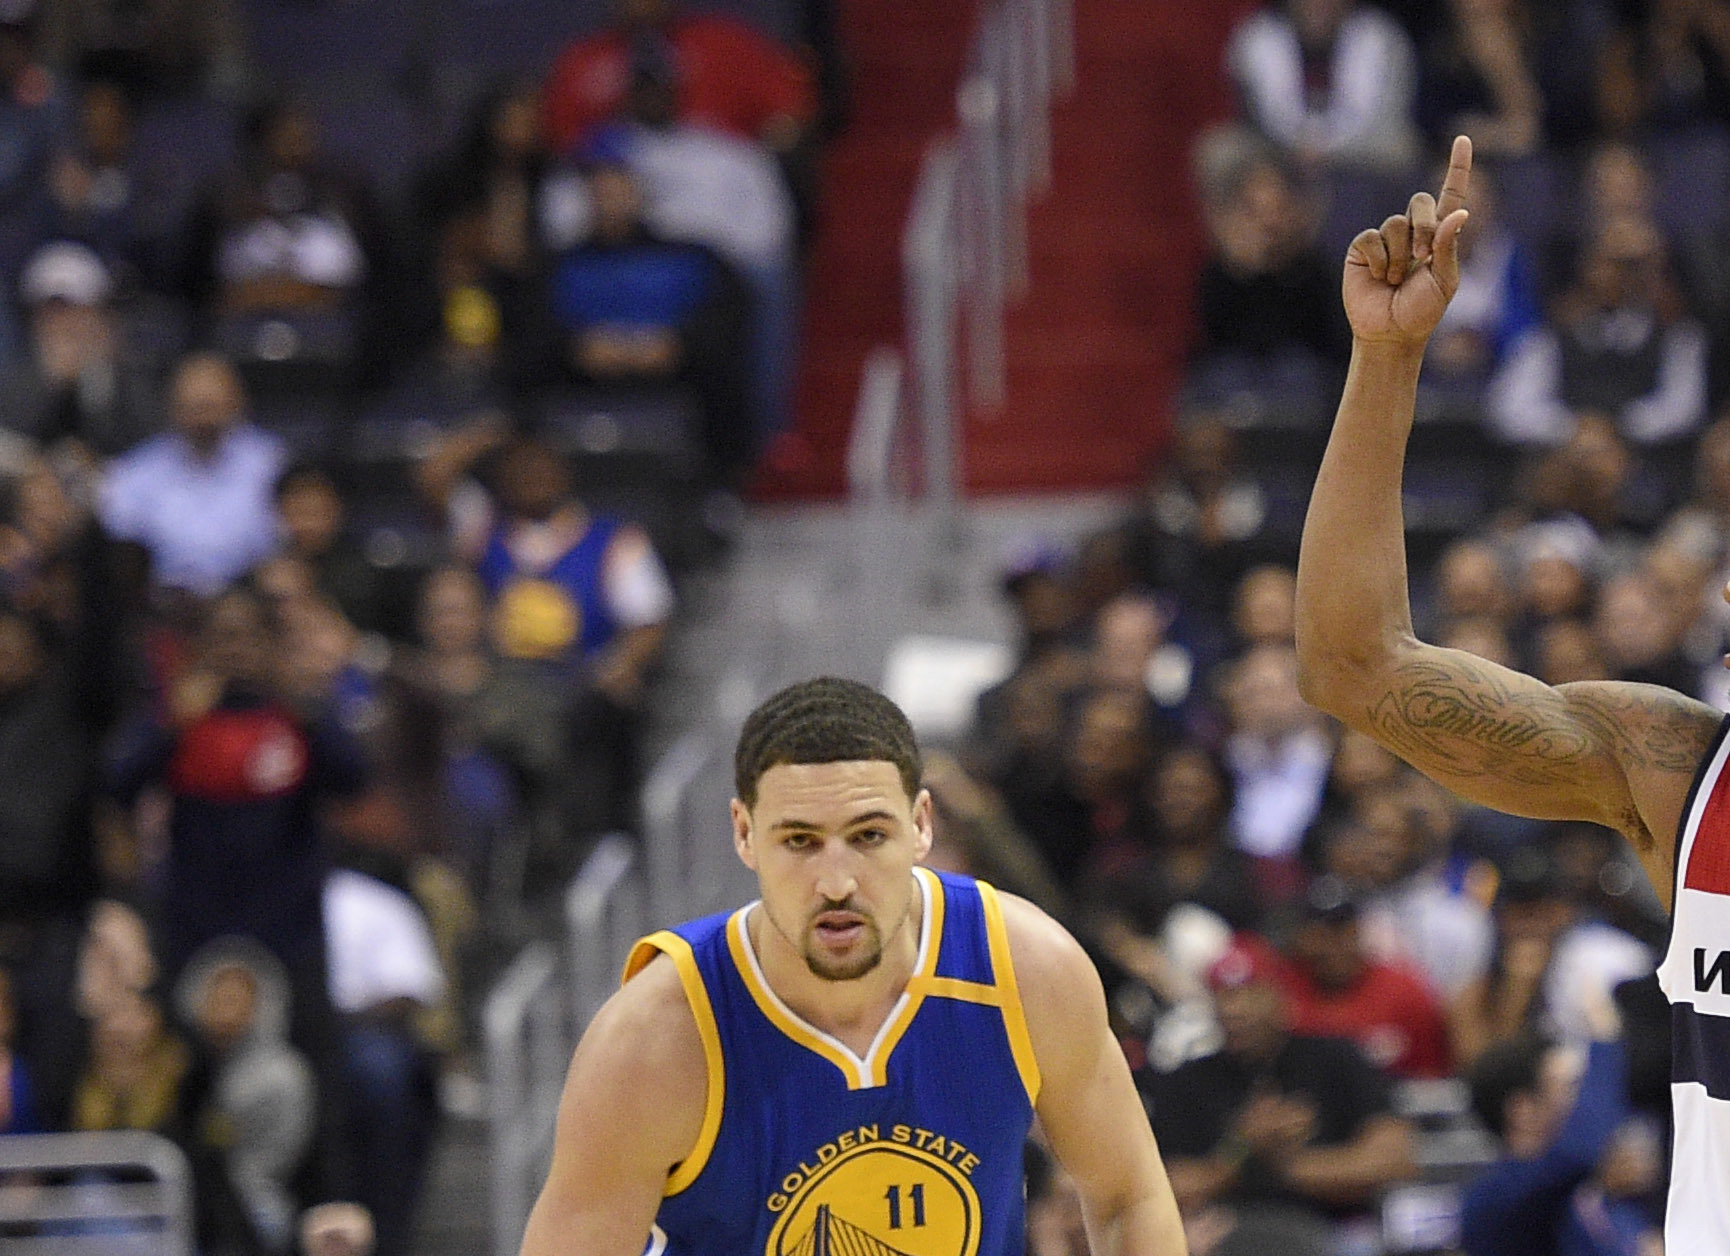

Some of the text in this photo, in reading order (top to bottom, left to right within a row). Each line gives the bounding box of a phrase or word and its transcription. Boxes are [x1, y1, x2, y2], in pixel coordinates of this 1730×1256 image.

[766, 1123, 981, 1212] GOLDEN STATE
[883, 1183, 927, 1230] 11
